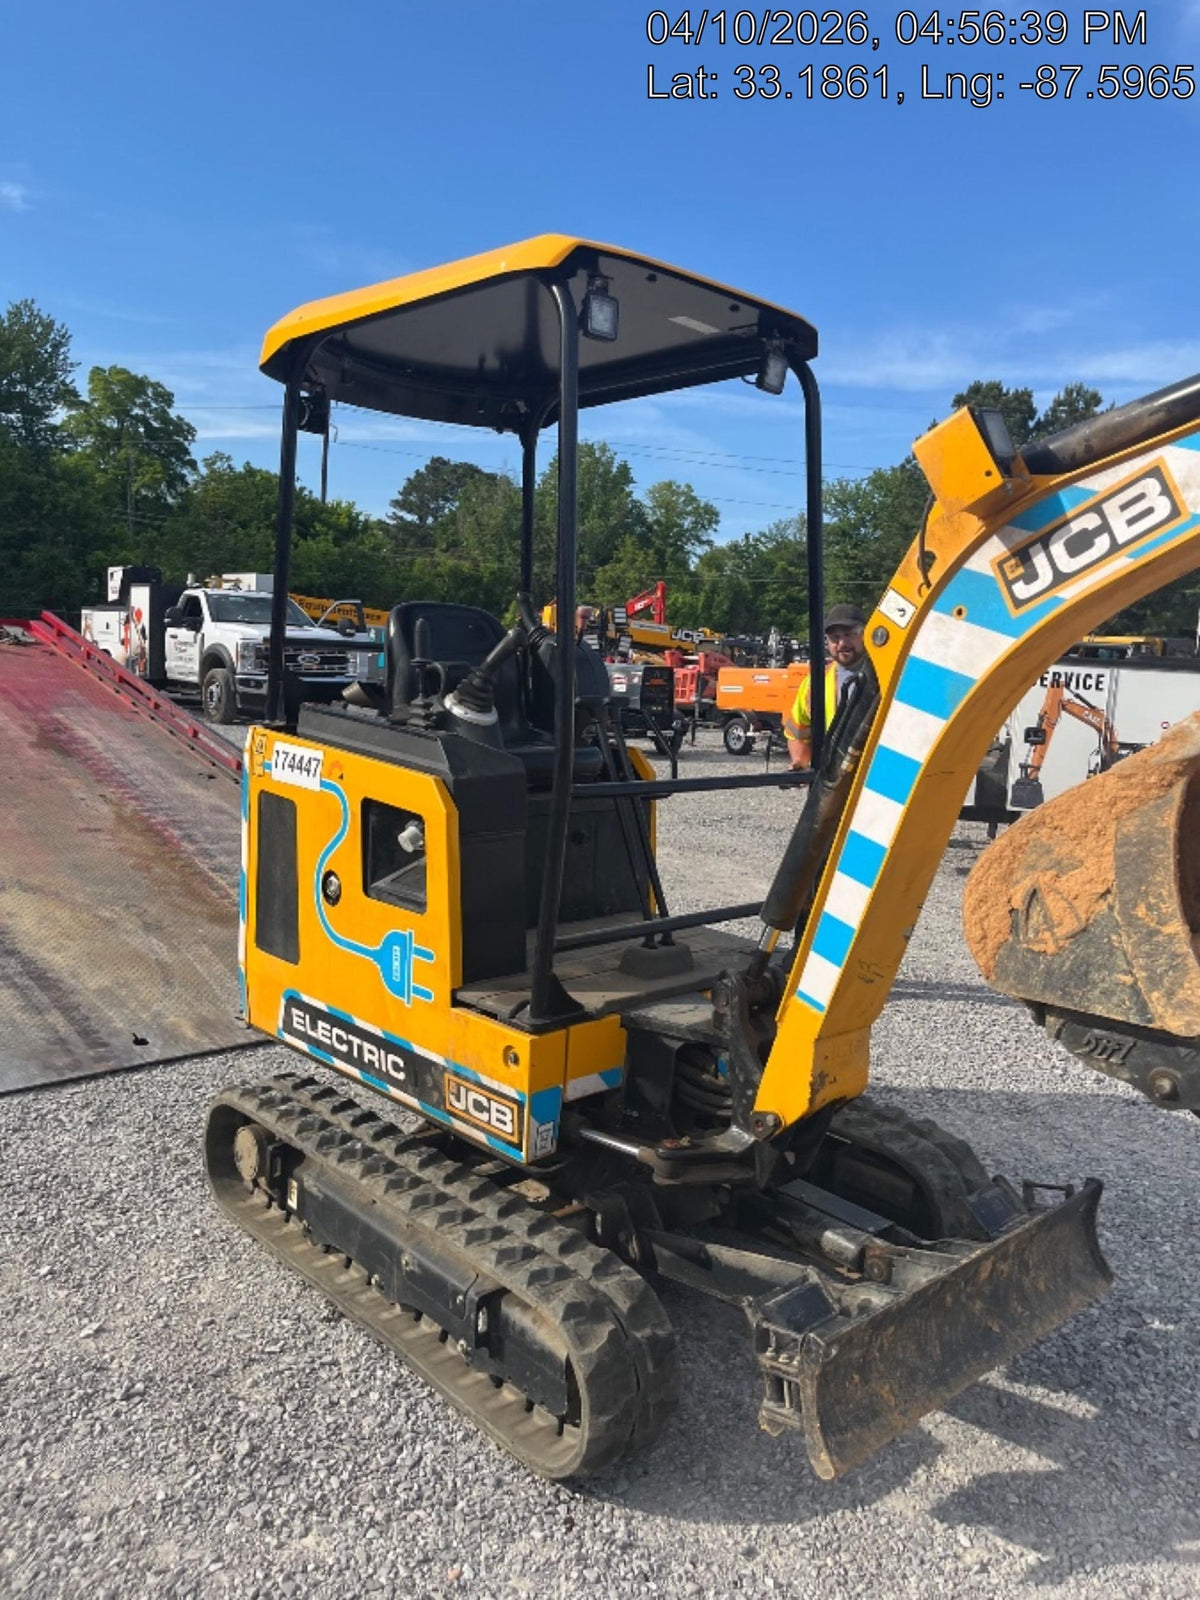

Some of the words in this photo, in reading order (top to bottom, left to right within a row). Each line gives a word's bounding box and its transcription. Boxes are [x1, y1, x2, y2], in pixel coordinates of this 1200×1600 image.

[1010, 477, 1172, 600] JCB
[1032, 671, 1105, 691] ERVICE
[274, 749, 321, 778] 174447
[290, 1006, 406, 1081] ELECTRIC
[448, 1084, 514, 1134] JCB
